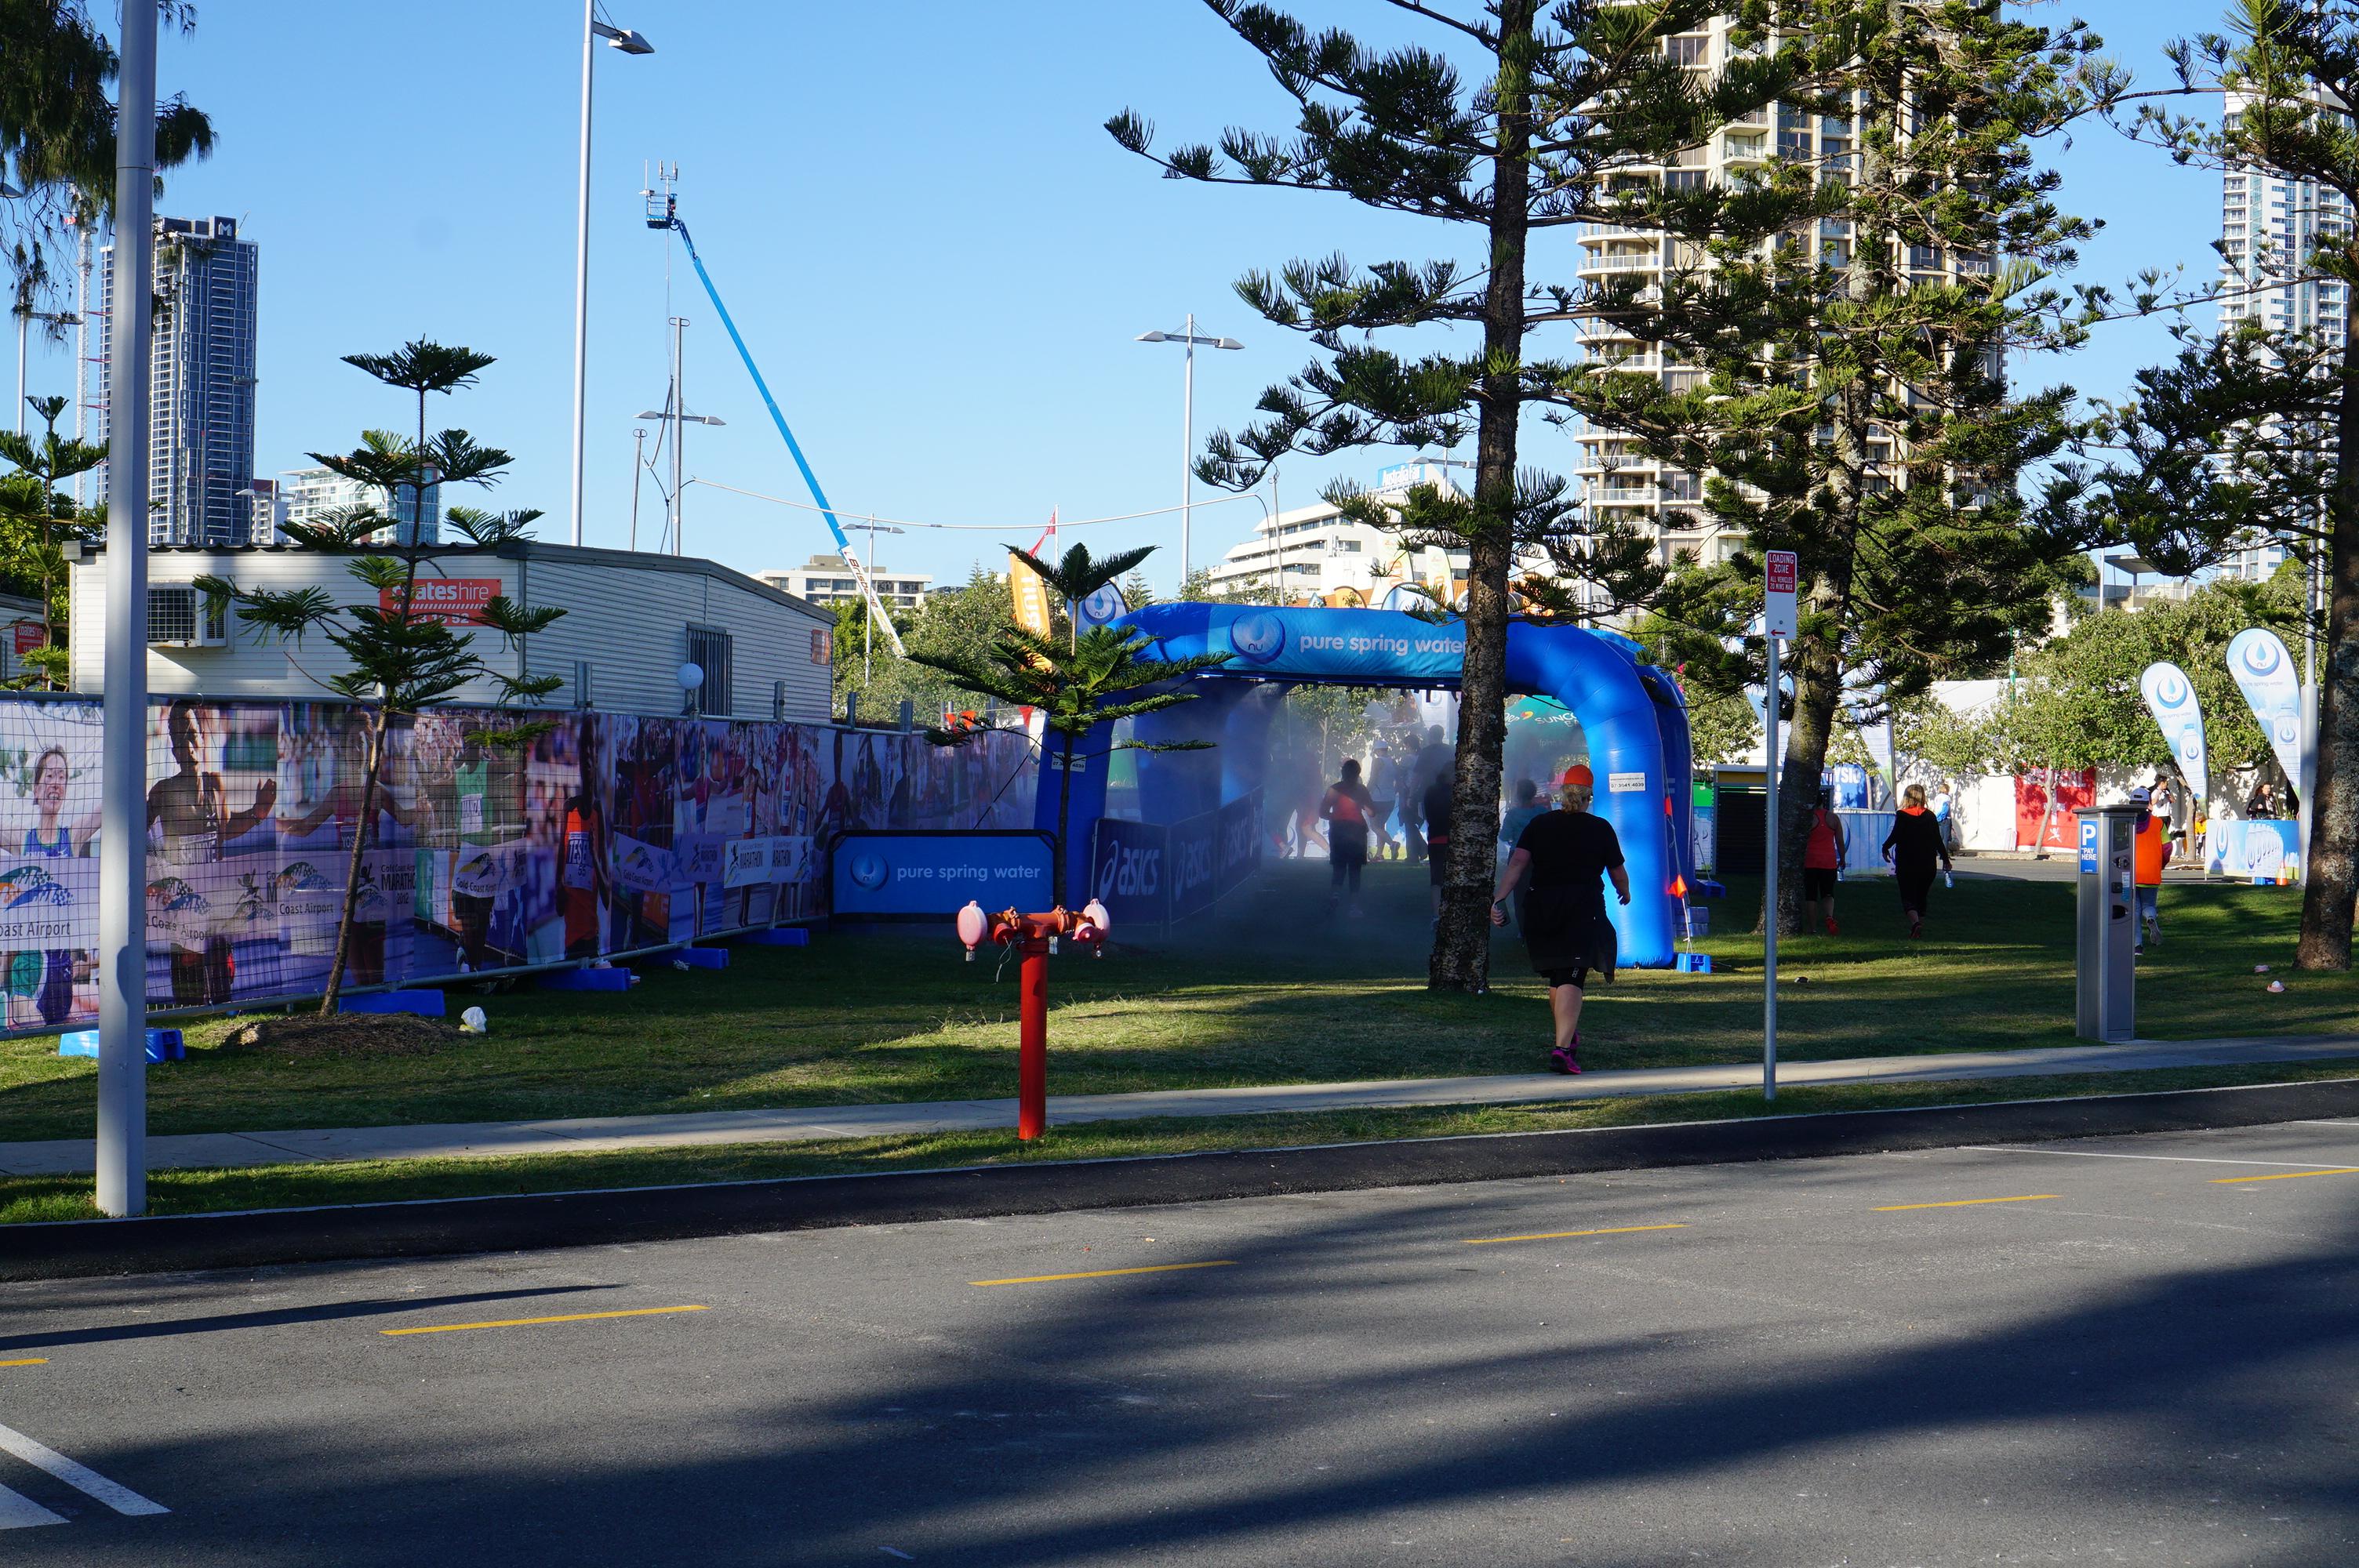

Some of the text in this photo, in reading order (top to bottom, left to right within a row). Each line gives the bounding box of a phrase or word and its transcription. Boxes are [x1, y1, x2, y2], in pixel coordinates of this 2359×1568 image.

[1383, 463, 1421, 487] Australia Fair
[1769, 554, 1794, 564] LOADING
[1774, 564, 1790, 574] ZONE
[392, 582, 489, 601] cateshire
[452, 612, 469, 624] 52
[1248, 642, 1263, 652] nu
[1300, 634, 1344, 653] pure
[1349, 633, 1408, 657] spring
[2082, 824, 2096, 846] P
[740, 851, 764, 869] MARATHON
[772, 849, 791, 868] ARATHON
[897, 864, 1041, 882] pure spring water
[1118, 847, 1161, 896] asics
[396, 892, 409, 905] 2012
[279, 902, 334, 916] Coast Airport
[27, 921, 71, 939] Airport
